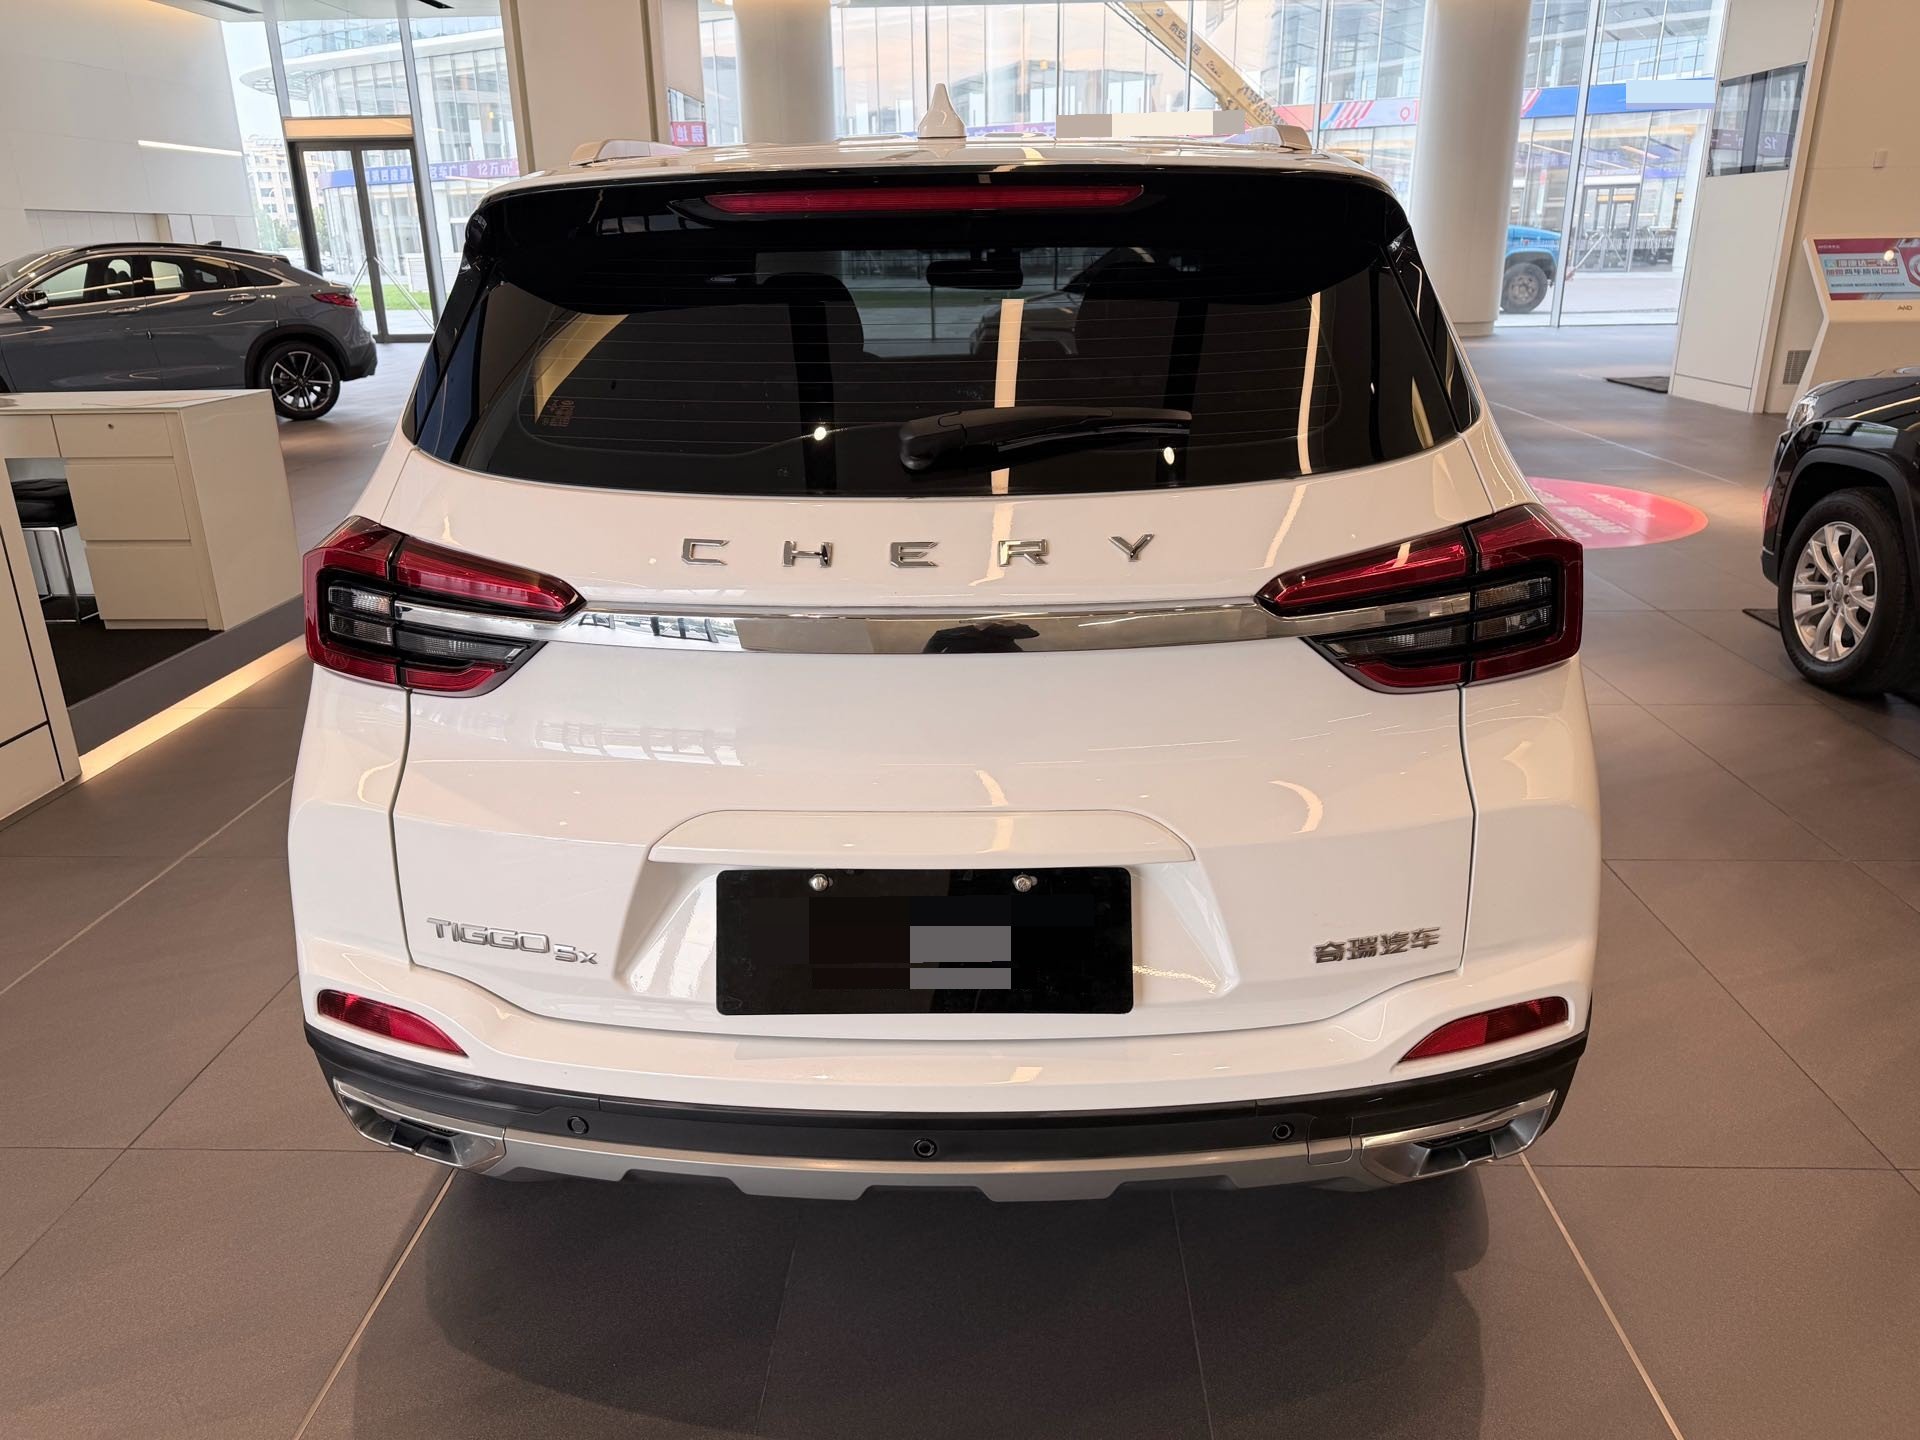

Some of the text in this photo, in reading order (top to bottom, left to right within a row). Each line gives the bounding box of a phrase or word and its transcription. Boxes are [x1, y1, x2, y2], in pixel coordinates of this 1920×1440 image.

[681, 533, 1155, 568] CHERY
[427, 917, 550, 954] TIGGO
[1315, 926, 1441, 964] 奇瑞汽车
